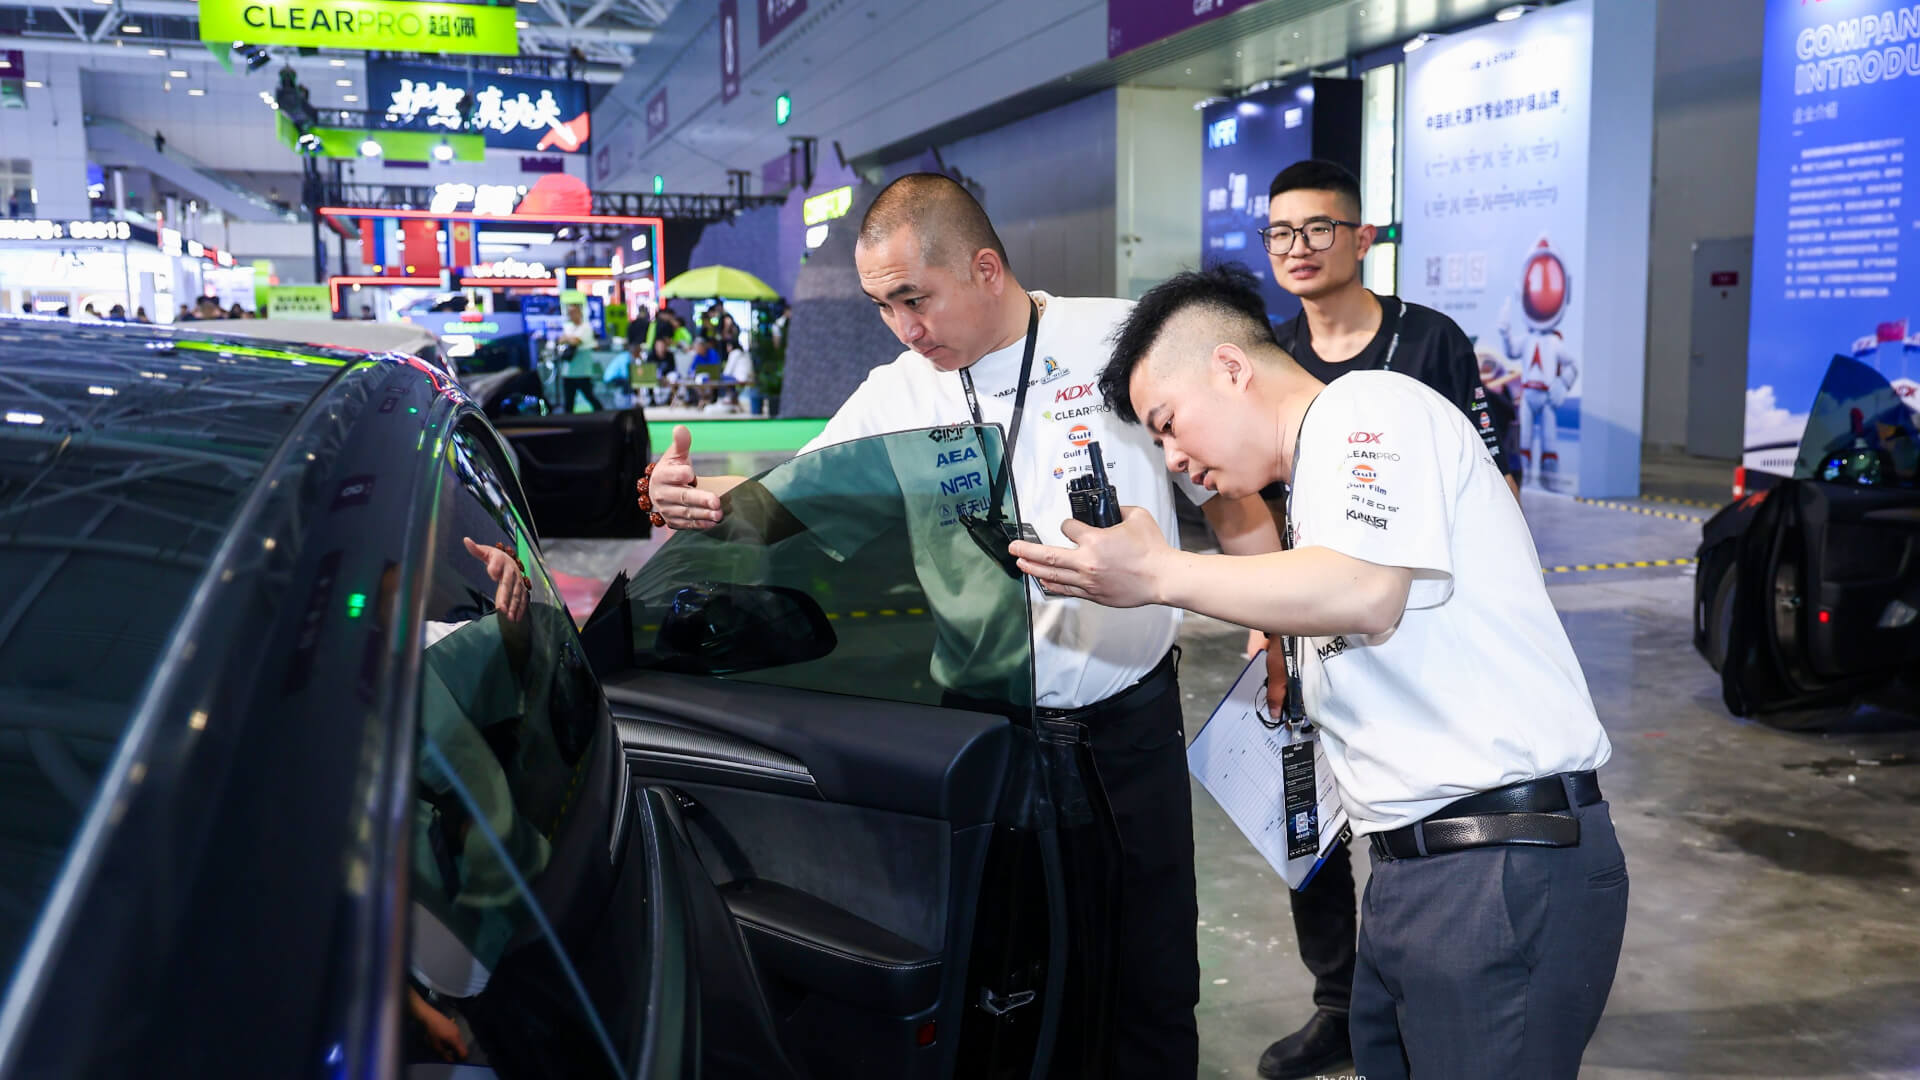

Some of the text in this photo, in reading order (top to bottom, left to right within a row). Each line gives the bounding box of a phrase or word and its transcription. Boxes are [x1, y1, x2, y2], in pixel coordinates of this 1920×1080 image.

[243, 5, 421, 37] CLEARPRO
[1208, 117, 1238, 149] NAR
[1054, 382, 1095, 404] KDX
[1055, 404, 1111, 421] CLEARPRO
[1068, 431, 1091, 441] Gulf
[936, 447, 978, 468] AEA
[1063, 449, 1081, 459] Gulf
[940, 471, 983, 497] NAR
[1351, 469, 1377, 478] Gulf
[1369, 484, 1388, 496] Film
[955, 495, 991, 516] 航天山
